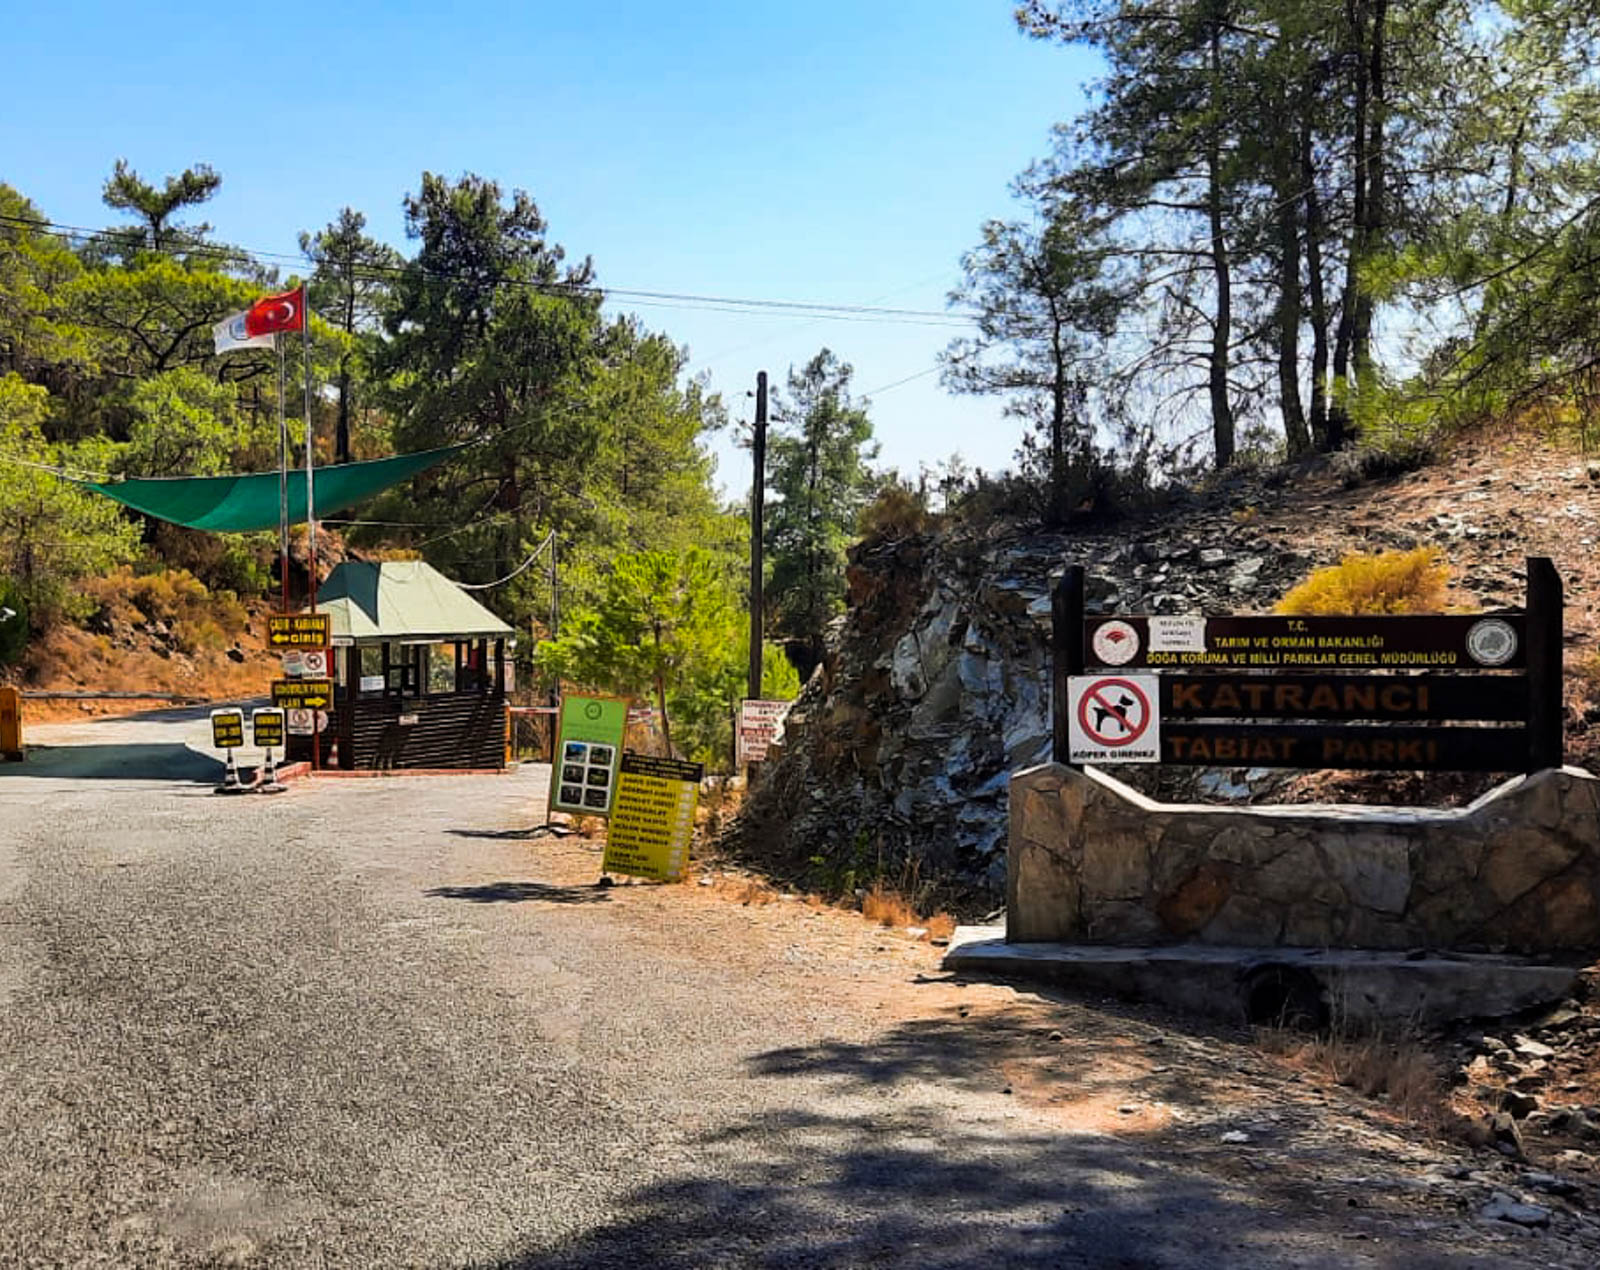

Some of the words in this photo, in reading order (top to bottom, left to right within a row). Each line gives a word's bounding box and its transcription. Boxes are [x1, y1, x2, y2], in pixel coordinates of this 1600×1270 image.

[1287, 620, 1309, 632] T.C.
[1214, 637, 1250, 648] TARIM
[1253, 637, 1269, 648] VE
[1271, 637, 1315, 648] ORMAN
[1318, 635, 1384, 648] BAKANLIĞI
[1146, 651, 1178, 664] DOĞA
[1181, 652, 1229, 664] KORUMA
[1232, 652, 1247, 664] VE
[1249, 651, 1280, 664] MİLLİ
[1283, 652, 1336, 665] PARKLAR
[1339, 652, 1378, 665] GENEL
[1381, 651, 1457, 665] MÜDÜRLÜĞÜ
[1171, 683, 1430, 712] KATRANCI
[1167, 732, 1298, 761] TABİAT
[1321, 737, 1438, 763] PARKI
